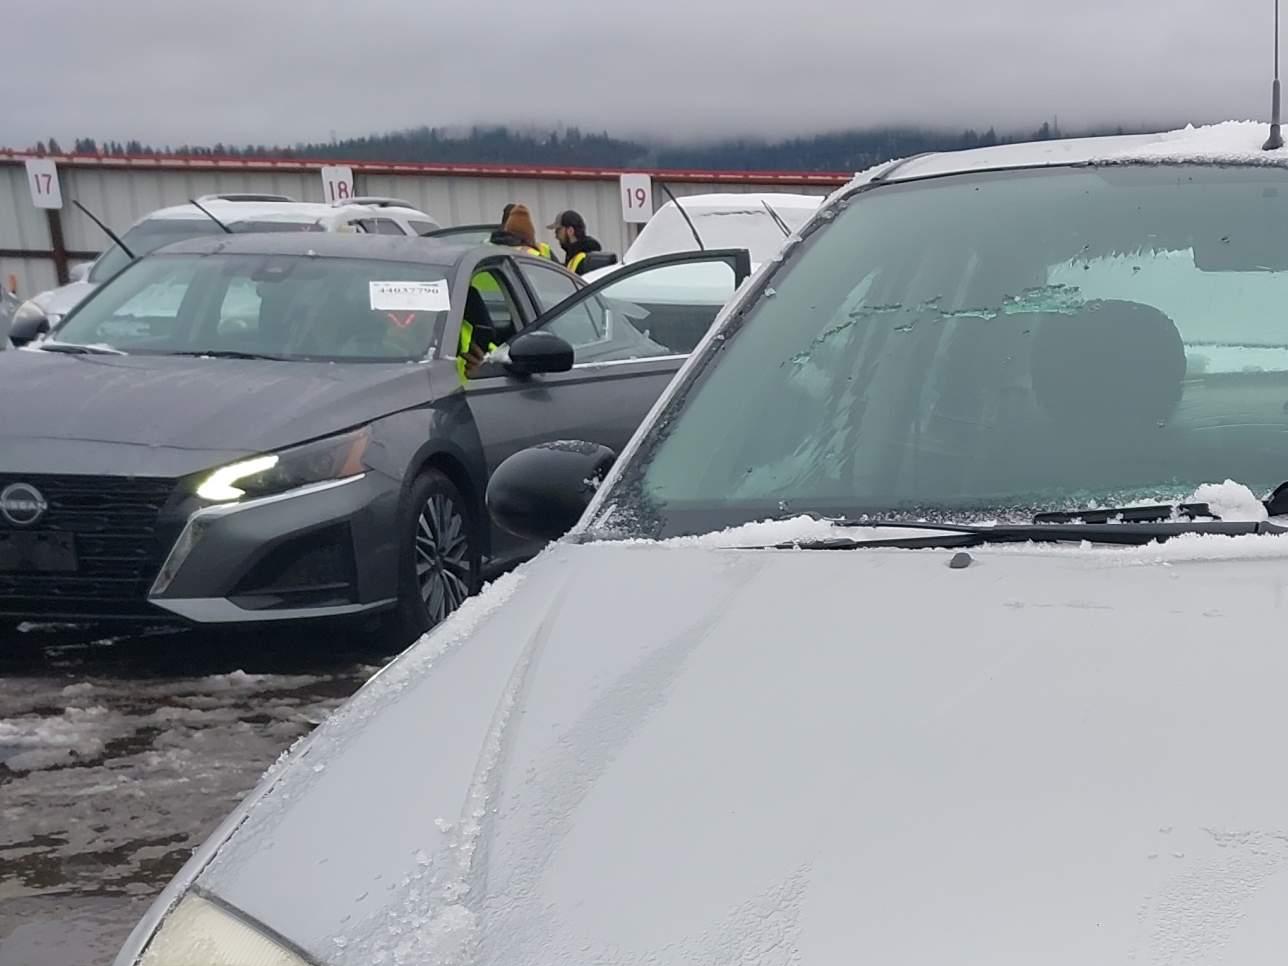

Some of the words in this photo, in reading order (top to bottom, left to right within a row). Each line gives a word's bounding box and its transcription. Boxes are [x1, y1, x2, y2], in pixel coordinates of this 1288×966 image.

[34, 173, 52, 195] 17
[329, 181, 349, 200] 18
[627, 188, 646, 208] 19
